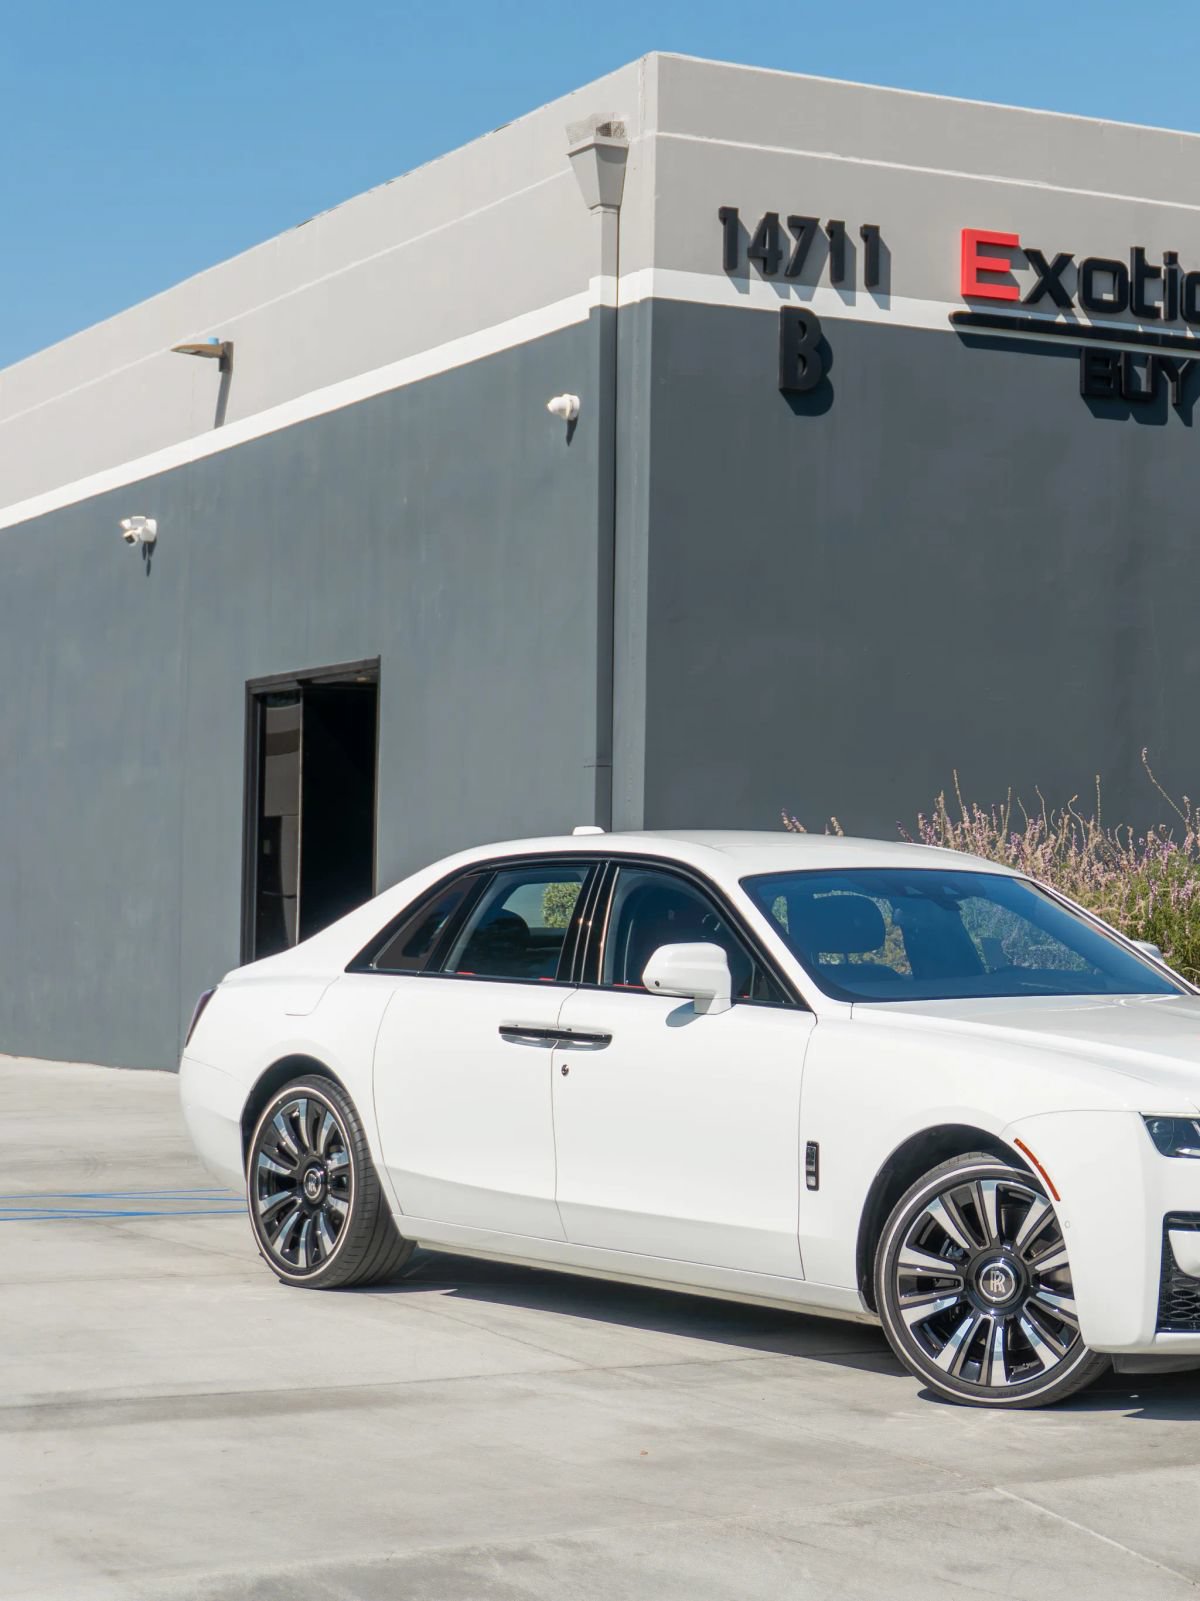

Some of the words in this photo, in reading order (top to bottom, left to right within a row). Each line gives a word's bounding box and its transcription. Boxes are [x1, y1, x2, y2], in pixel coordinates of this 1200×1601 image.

[718, 206, 881, 287] 14711
[779, 304, 823, 392] B
[1079, 346, 1198, 406] BUY
